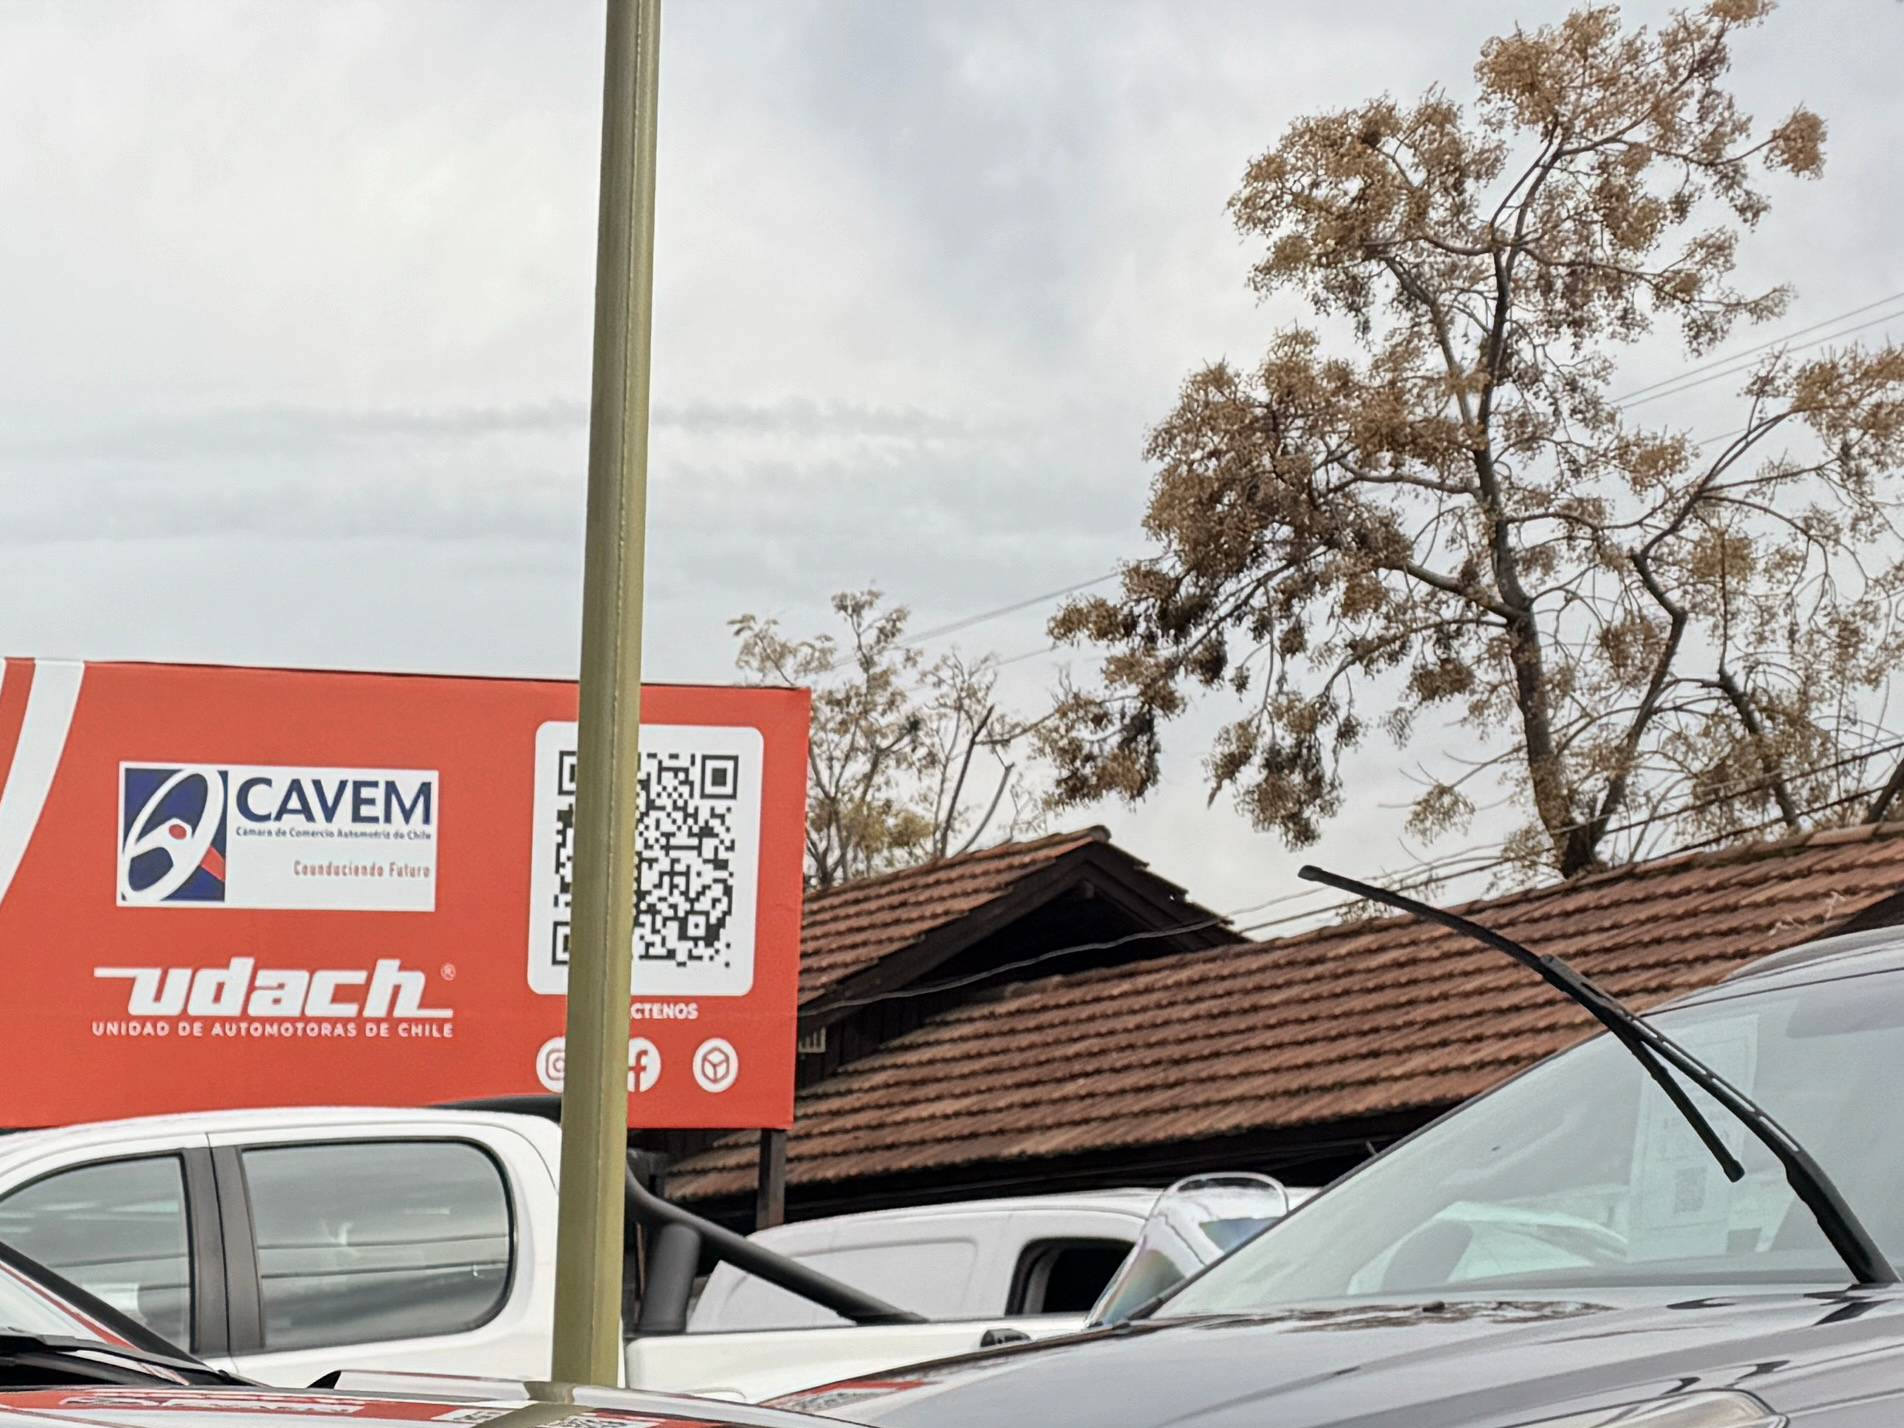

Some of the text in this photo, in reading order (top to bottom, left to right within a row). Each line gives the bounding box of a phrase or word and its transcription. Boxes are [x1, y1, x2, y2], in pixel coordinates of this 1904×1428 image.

[236, 777, 432, 825] CAVEM
[275, 827, 286, 837] de
[289, 827, 334, 838] Comercio
[337, 828, 390, 839] Automotriz
[407, 829, 431, 841] Chile
[389, 862, 431, 878] Futuro
[93, 957, 453, 1018] udach
[630, 1002, 699, 1020] CTENOS
[92, 1020, 453, 1039] UNIDAD DE AUTOMOTORAS DE CHILE
